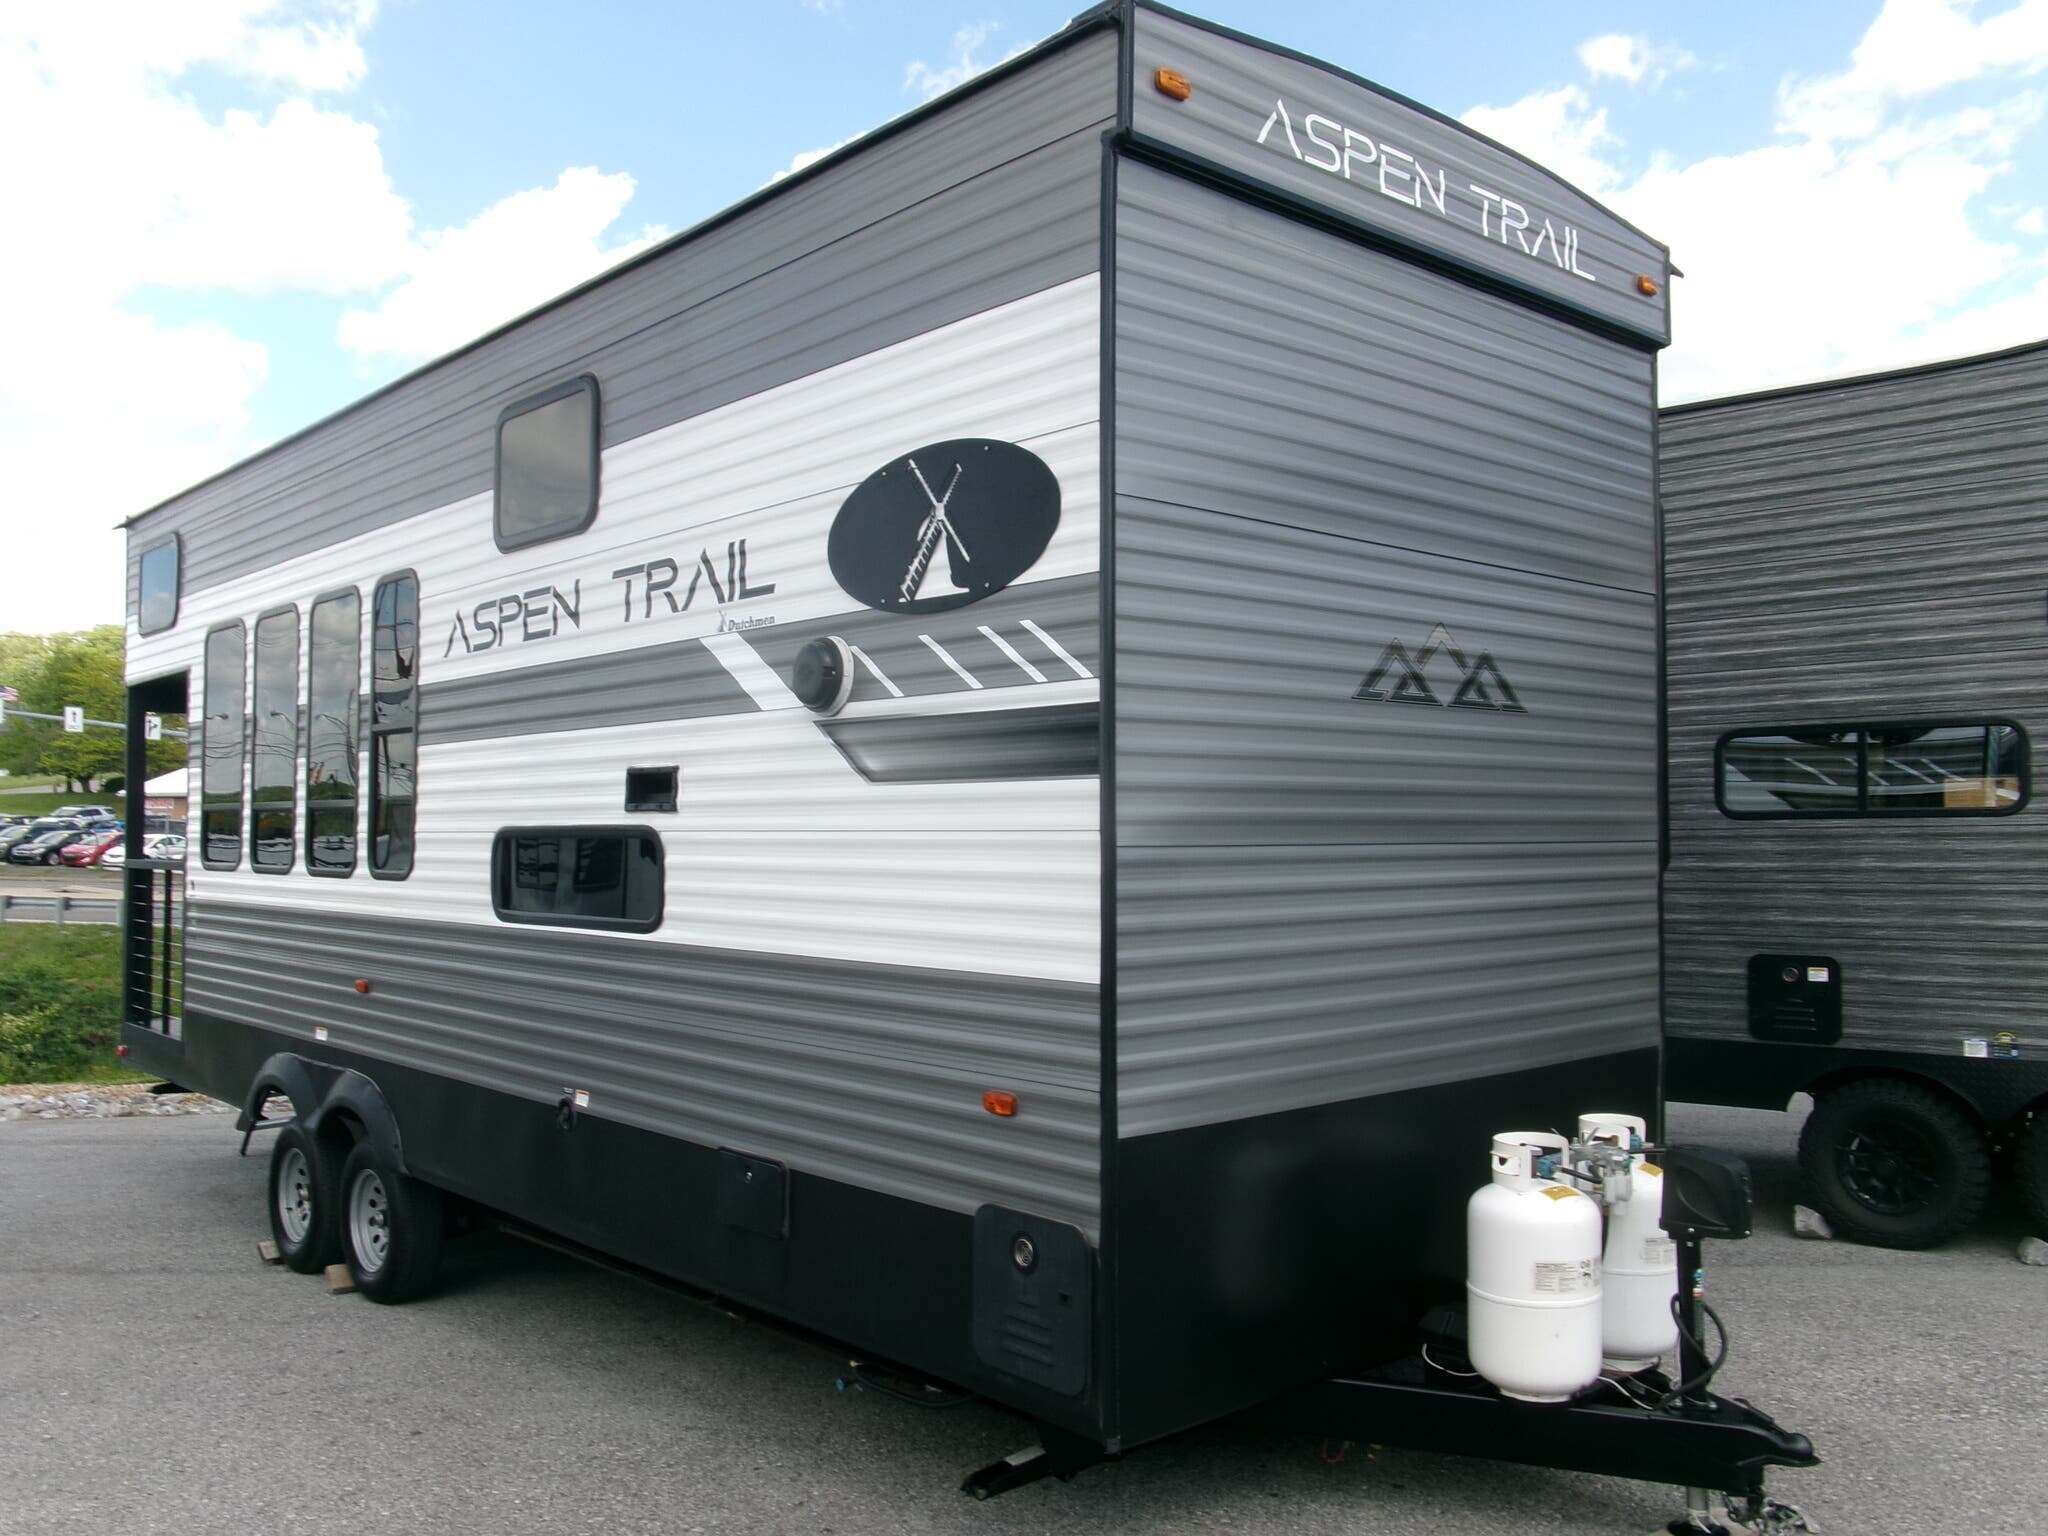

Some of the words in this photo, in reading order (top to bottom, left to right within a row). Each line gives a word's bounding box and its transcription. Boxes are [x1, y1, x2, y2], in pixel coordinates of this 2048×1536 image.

[1256, 98, 1446, 215] ASPEN
[1469, 183, 1597, 281] TRAIL
[444, 578, 581, 658] ASPEN
[612, 538, 777, 622] TRAIL
